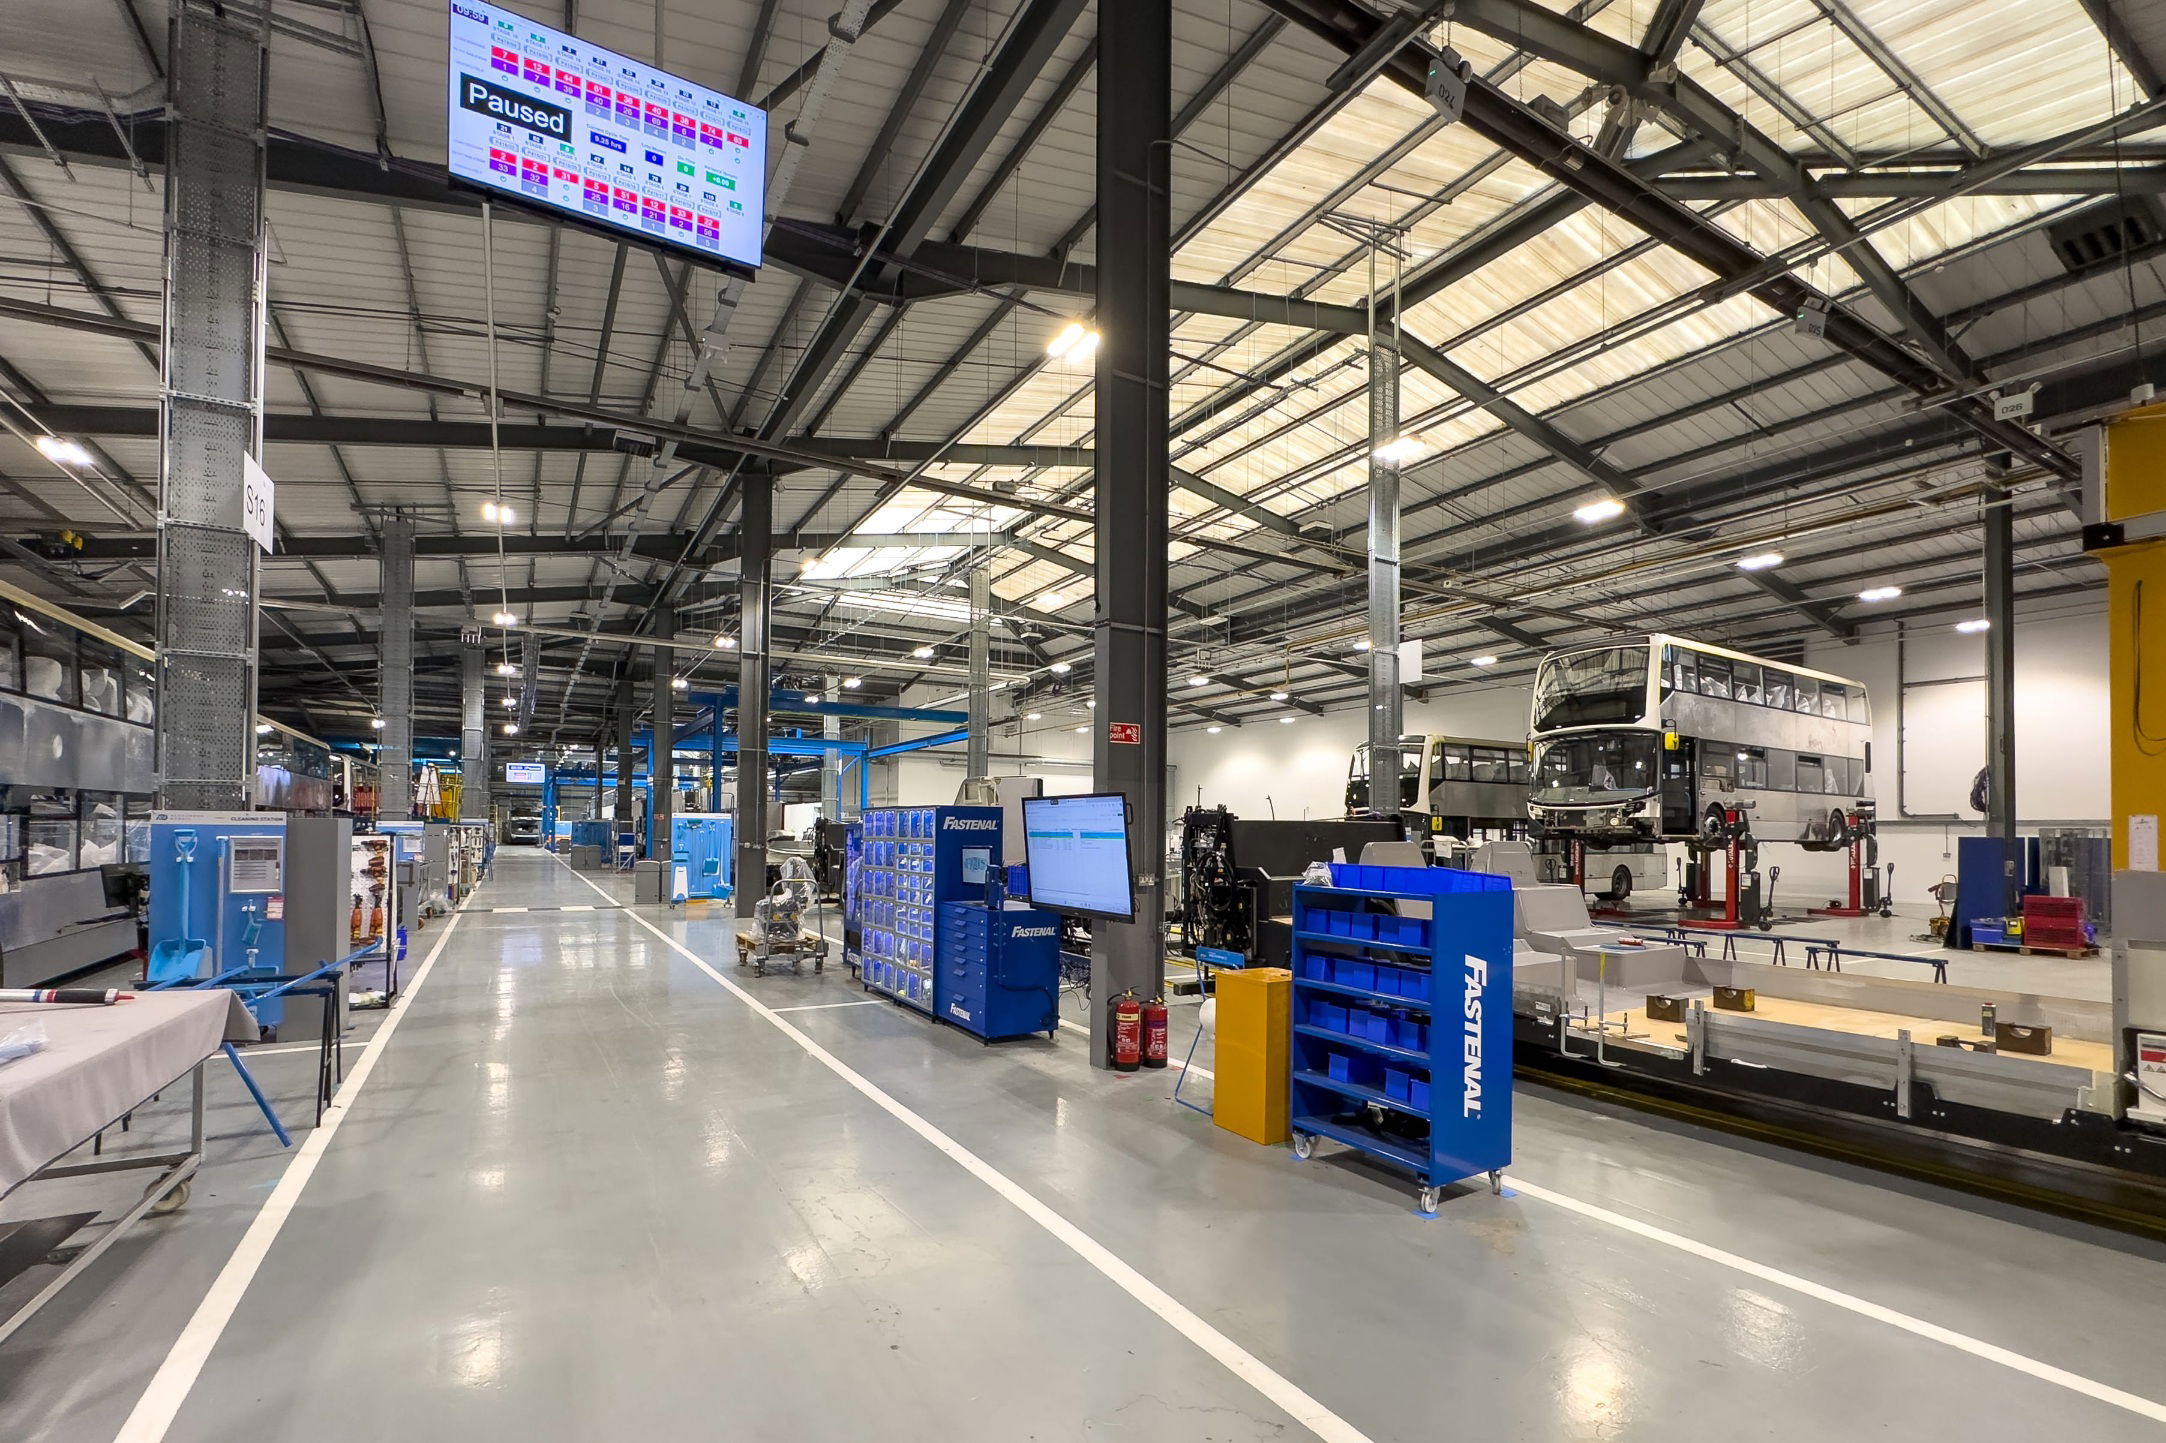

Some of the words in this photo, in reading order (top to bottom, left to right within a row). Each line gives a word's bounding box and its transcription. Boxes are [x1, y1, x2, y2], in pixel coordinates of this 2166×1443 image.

[468, 82, 565, 134] Paused
[246, 484, 265, 527] S16
[943, 816, 998, 830] FASTENAL
[1011, 926, 1057, 938] FASTENAL
[1464, 954, 1488, 1118] FASTENAL
